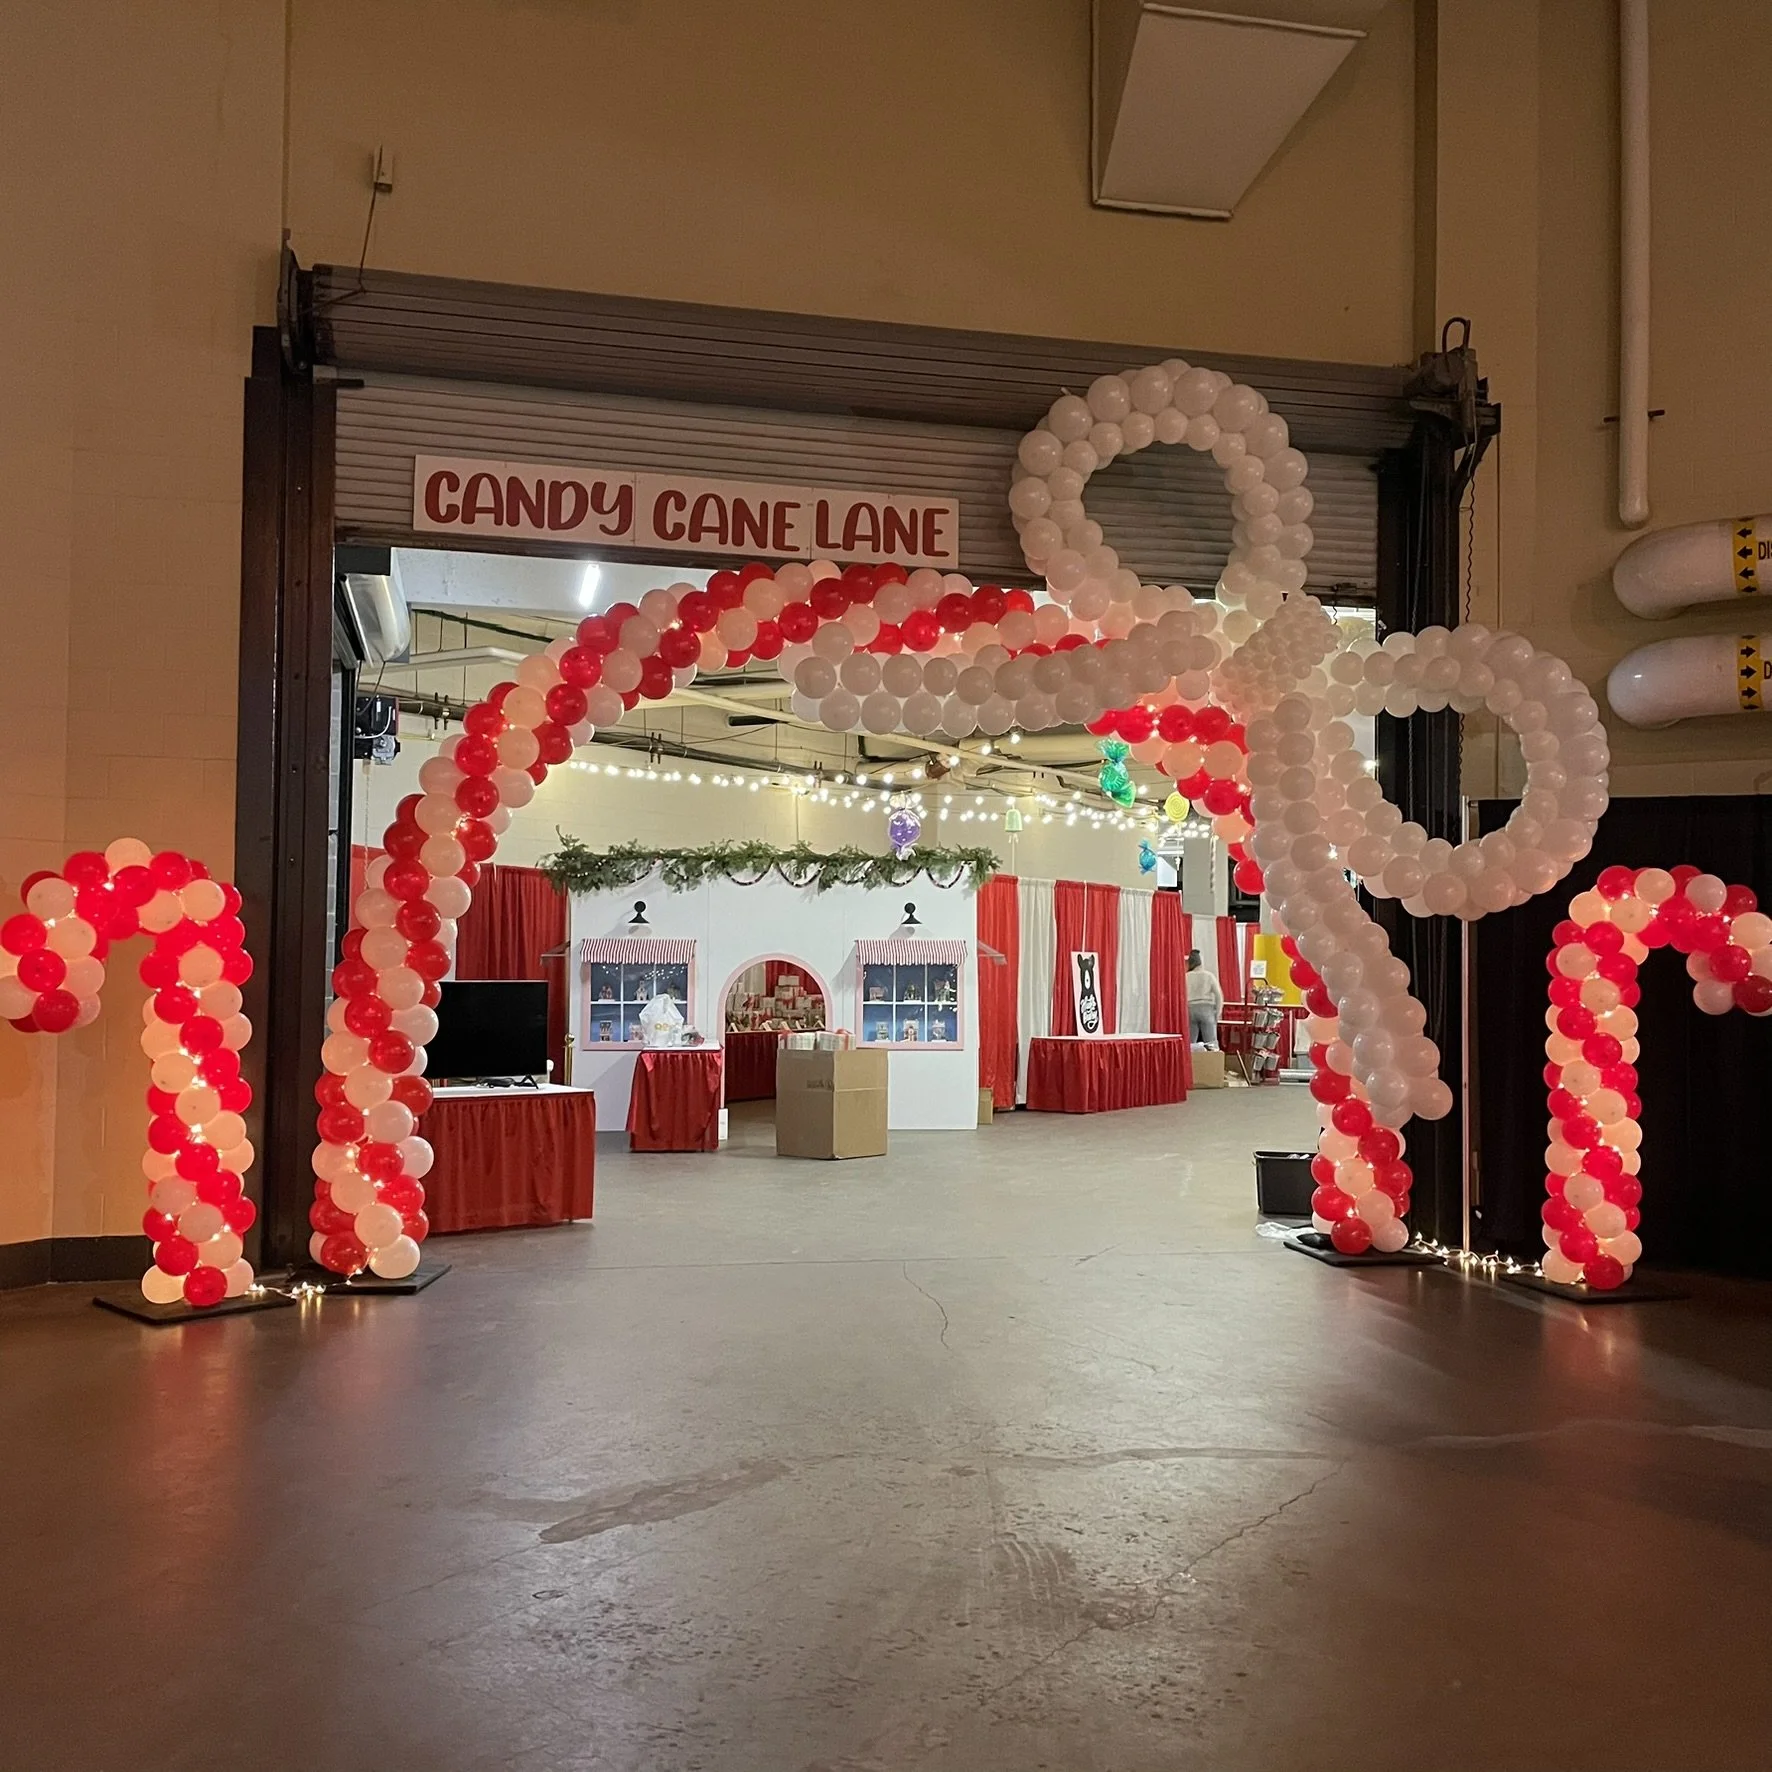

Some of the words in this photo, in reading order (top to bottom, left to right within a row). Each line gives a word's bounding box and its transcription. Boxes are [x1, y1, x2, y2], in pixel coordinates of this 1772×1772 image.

[424, 470, 634, 536] CANDY
[652, 489, 801, 553] CANE
[815, 499, 951, 557] LANE
[1758, 540, 1772, 560] DI
